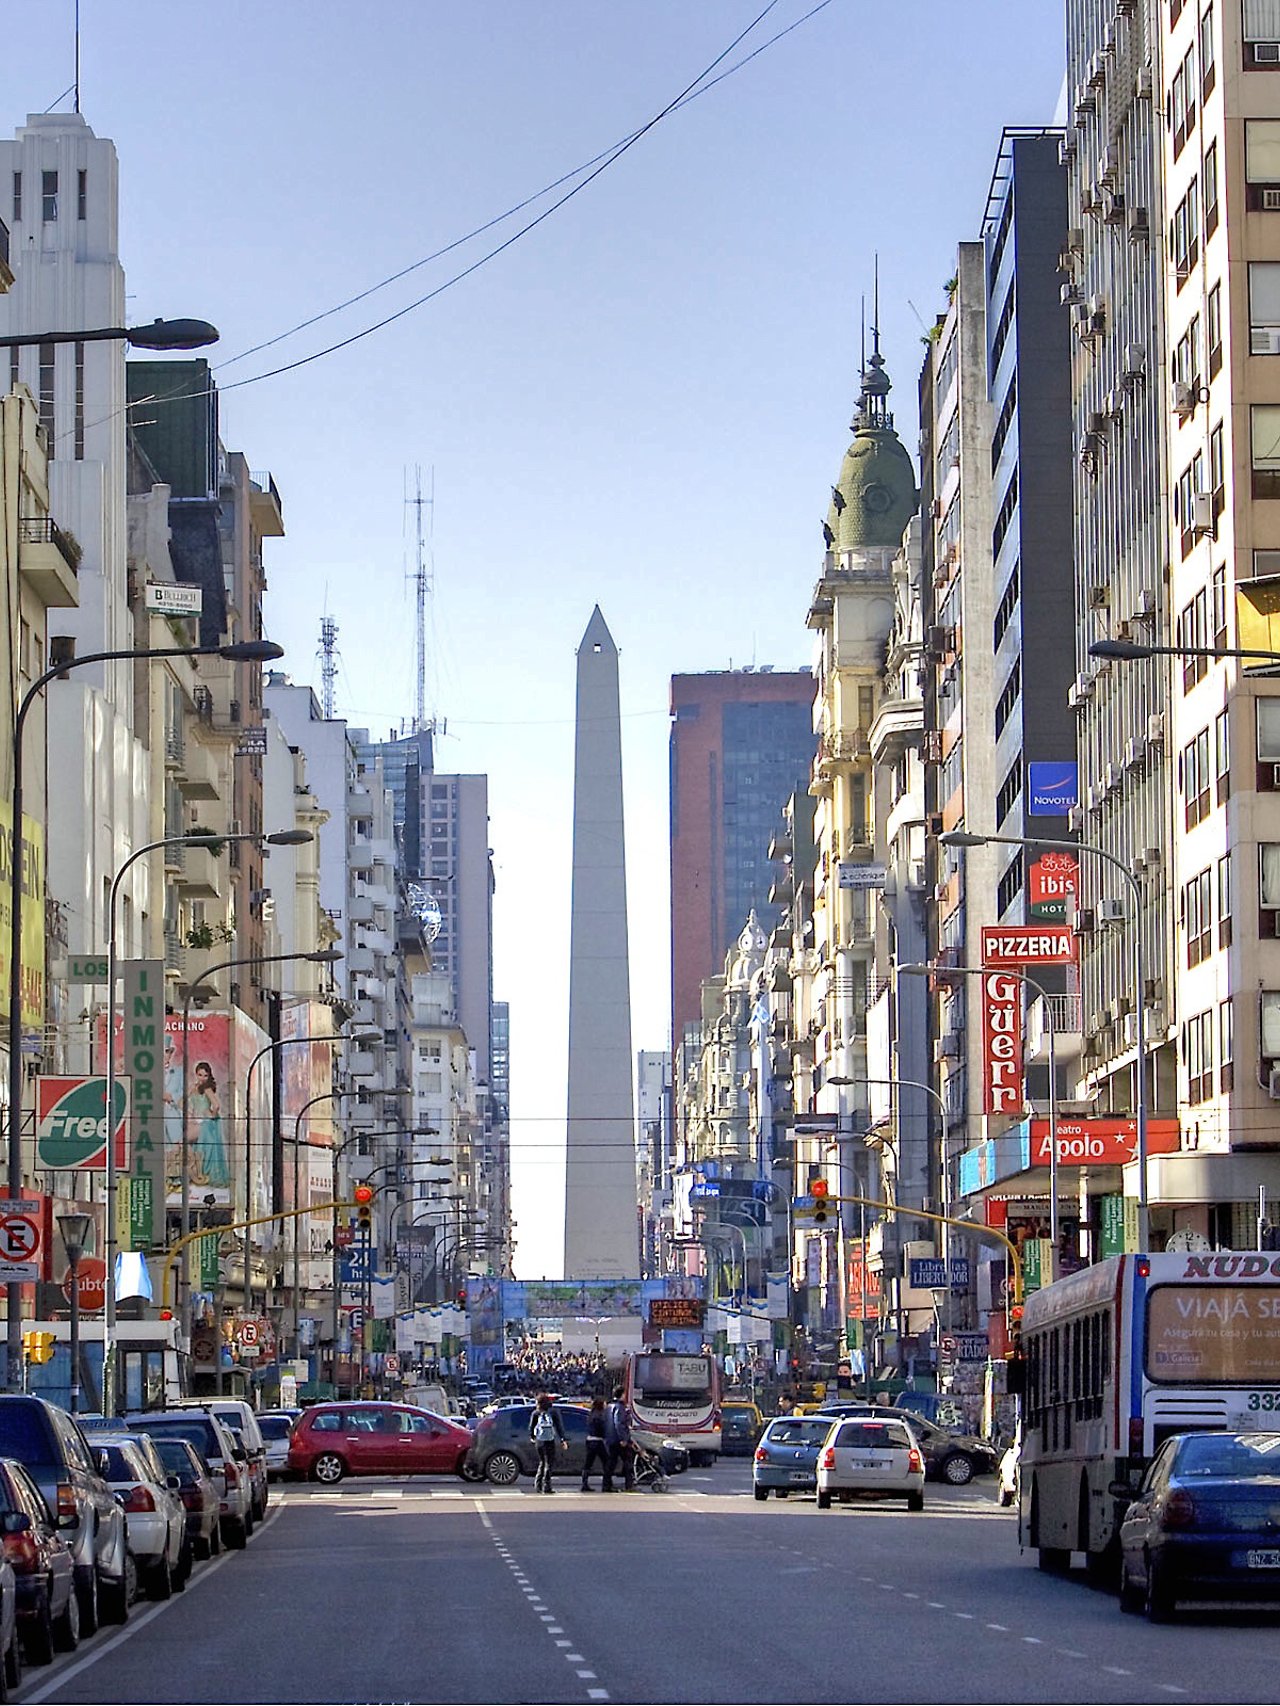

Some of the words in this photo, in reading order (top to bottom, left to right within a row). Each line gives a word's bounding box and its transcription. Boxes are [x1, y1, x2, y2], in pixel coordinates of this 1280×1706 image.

[1034, 796, 1076, 805] NOVOTEL
[1040, 876, 1074, 894] ibis
[986, 936, 1071, 957] PIZZERIA
[73, 963, 108, 976] LOS
[1057, 1126, 1082, 1134] eatro
[1038, 1133, 1105, 1163] Apolo
[914, 1272, 968, 1284] LIBERTDOR
[1177, 1293, 1250, 1324] VIAJÁ
